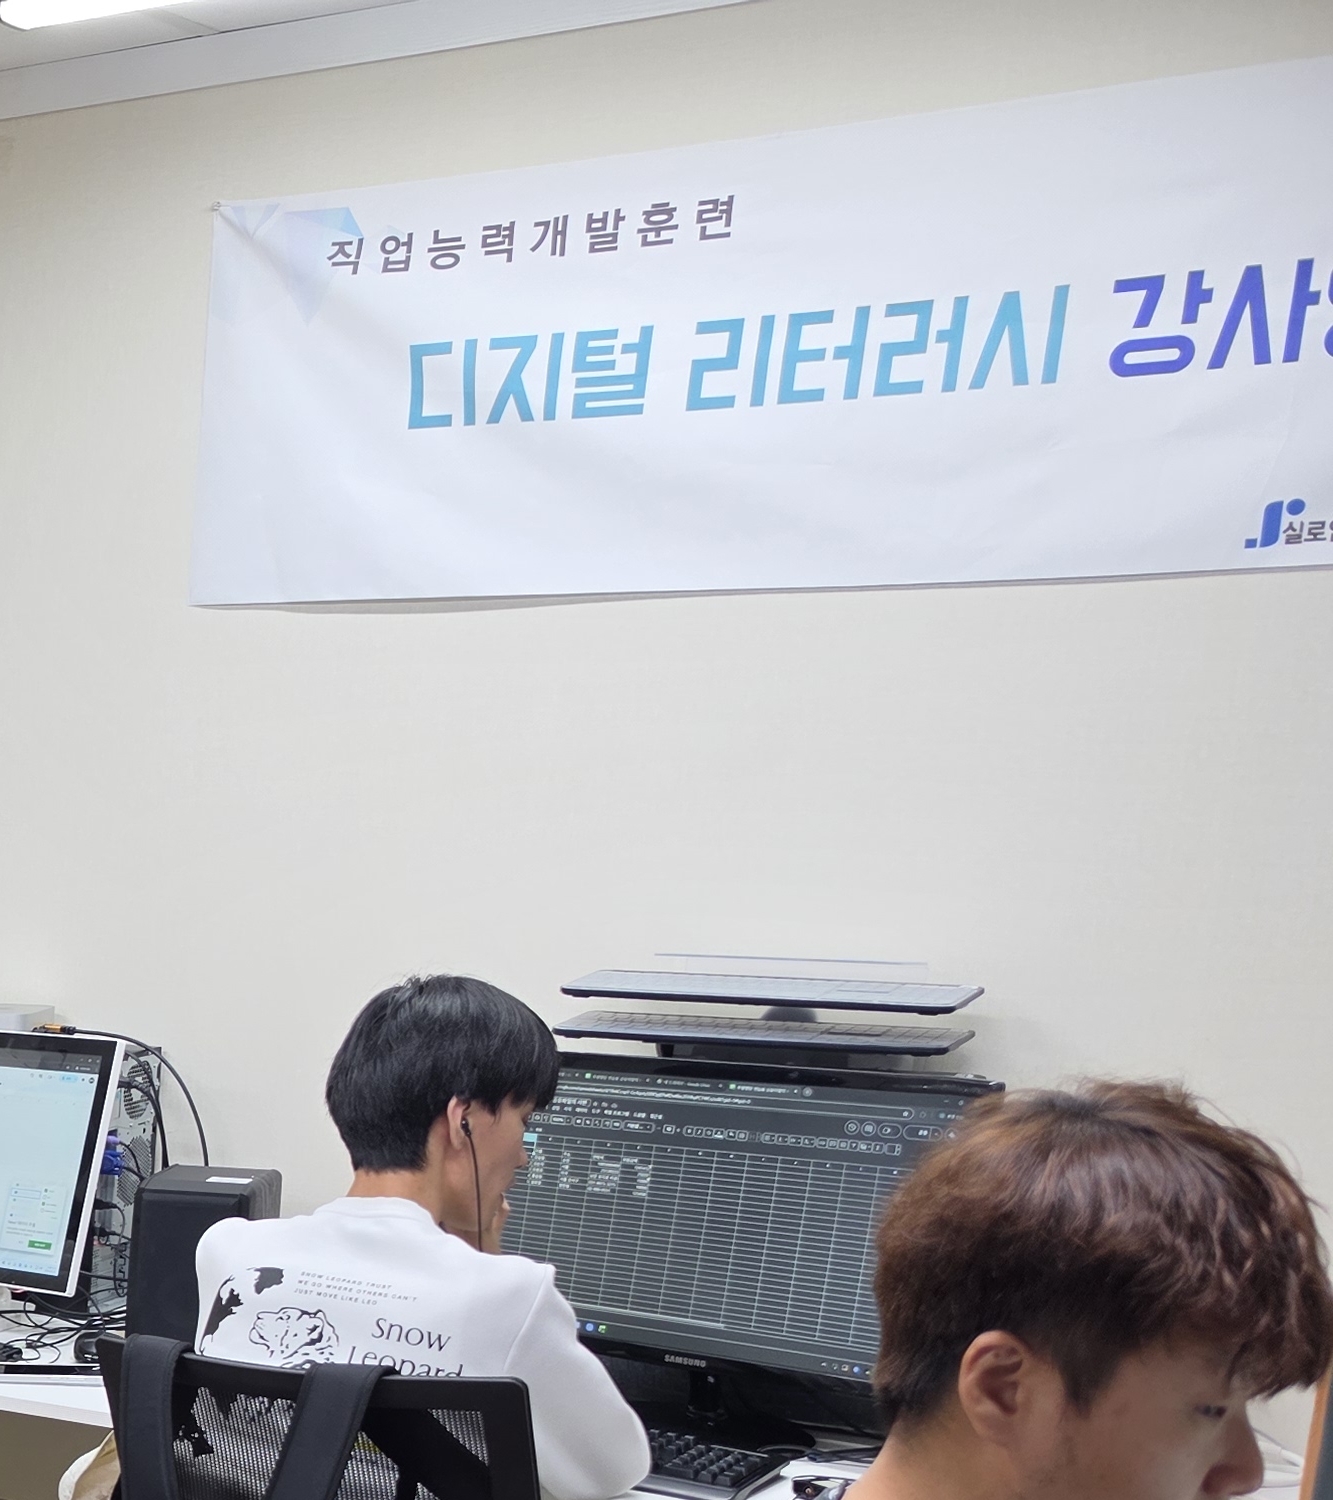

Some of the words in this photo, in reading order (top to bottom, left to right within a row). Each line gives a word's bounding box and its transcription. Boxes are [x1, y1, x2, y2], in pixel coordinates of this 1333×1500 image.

[325, 192, 738, 277] 직업능력개발훈련
[407, 324, 654, 431] 디지털
[685, 283, 1072, 413] 리터러시
[1109, 258, 1333, 377] 강사
[301, 1271, 324, 1279] SNOW
[326, 1276, 363, 1286] LEOPARD
[366, 1282, 392, 1290] TRUST
[326, 1284, 353, 1293] WHERE
[356, 1289, 388, 1298] OTHERS
[341, 1295, 359, 1303] LIKE
[371, 1317, 451, 1352] Snow
[664, 1354, 706, 1368] SAMSUNG
